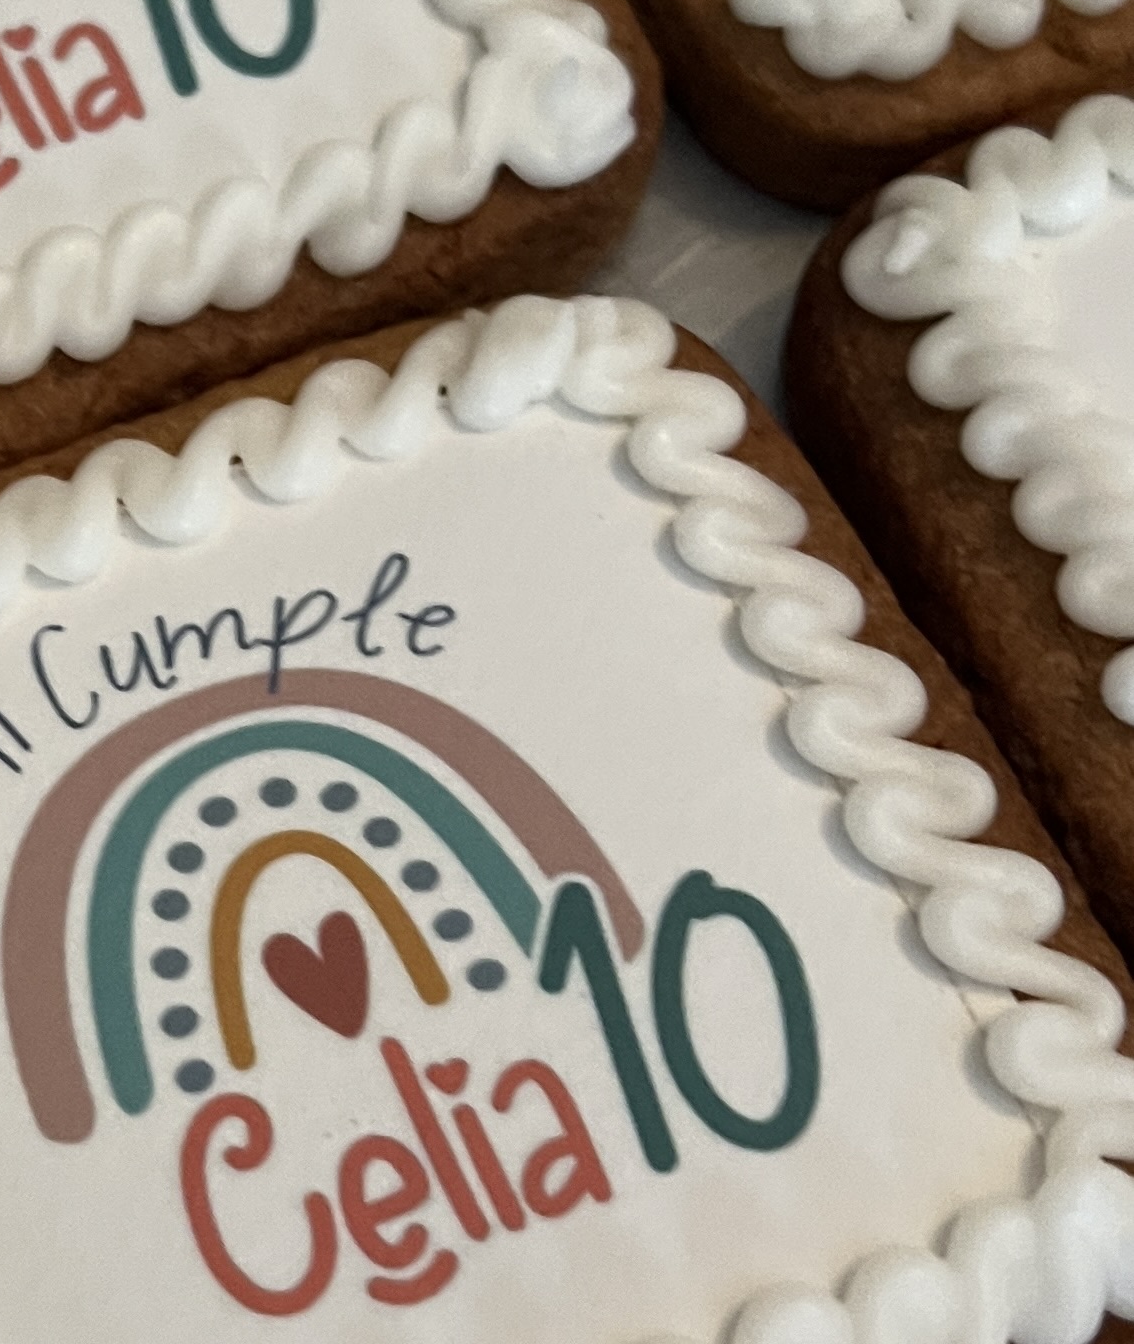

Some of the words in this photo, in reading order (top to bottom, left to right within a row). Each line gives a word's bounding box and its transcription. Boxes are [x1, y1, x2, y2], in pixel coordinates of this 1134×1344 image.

[29, 552, 459, 732] Cumple
[178, 1035, 614, 1317] Celia
[536, 869, 822, 1175] 10
